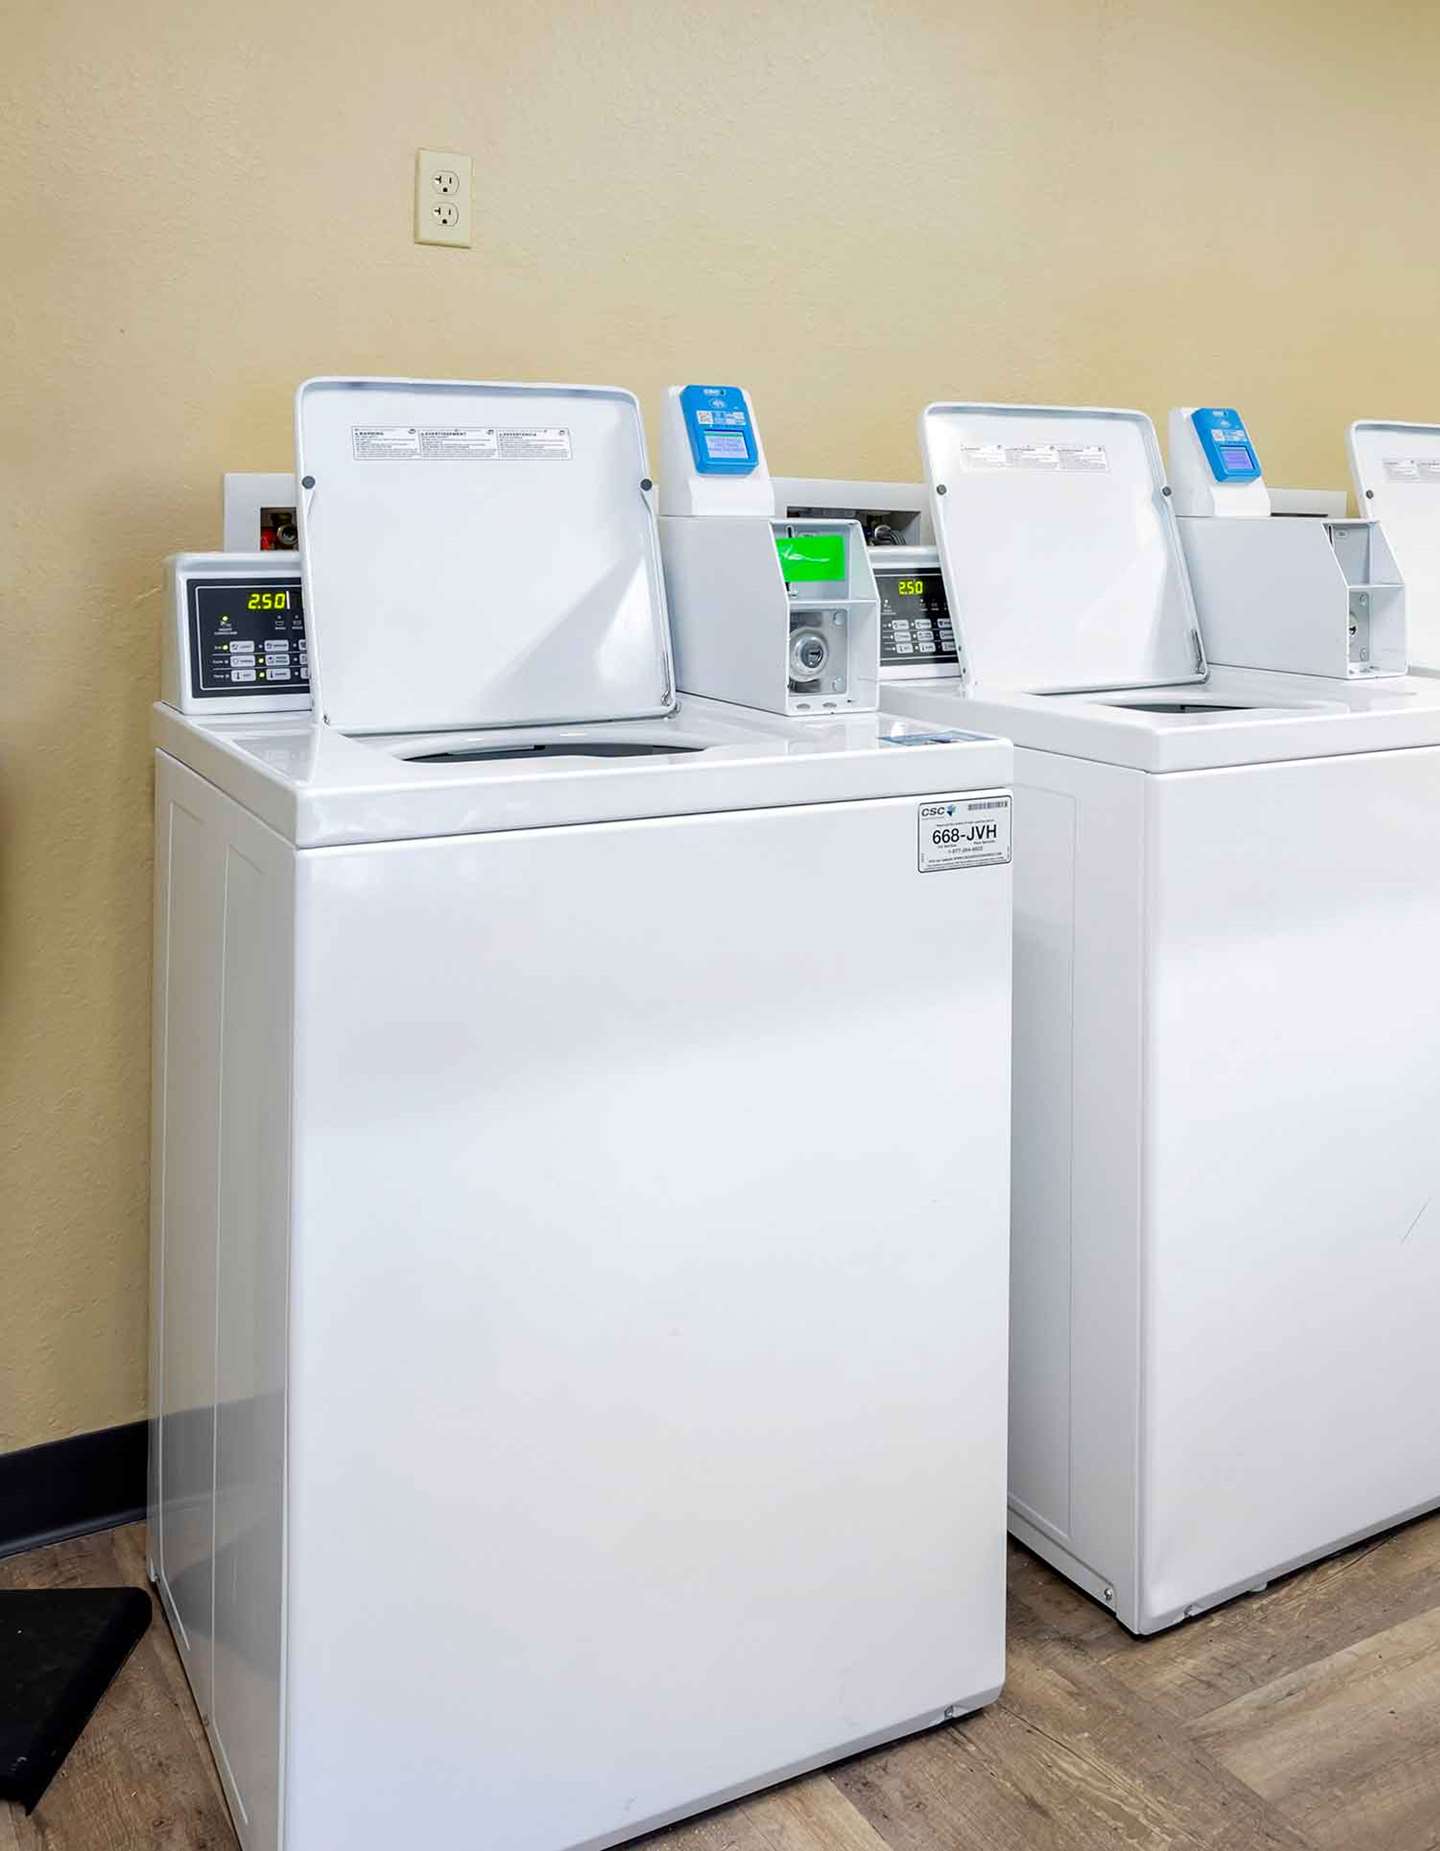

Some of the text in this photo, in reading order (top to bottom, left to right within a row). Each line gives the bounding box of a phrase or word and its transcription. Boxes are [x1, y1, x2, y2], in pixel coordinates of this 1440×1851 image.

[898, 581, 923, 595] 2.50
[247, 593, 286, 610] 2.50
[921, 806, 945, 817] CSC
[932, 824, 997, 845] 668-JVH
